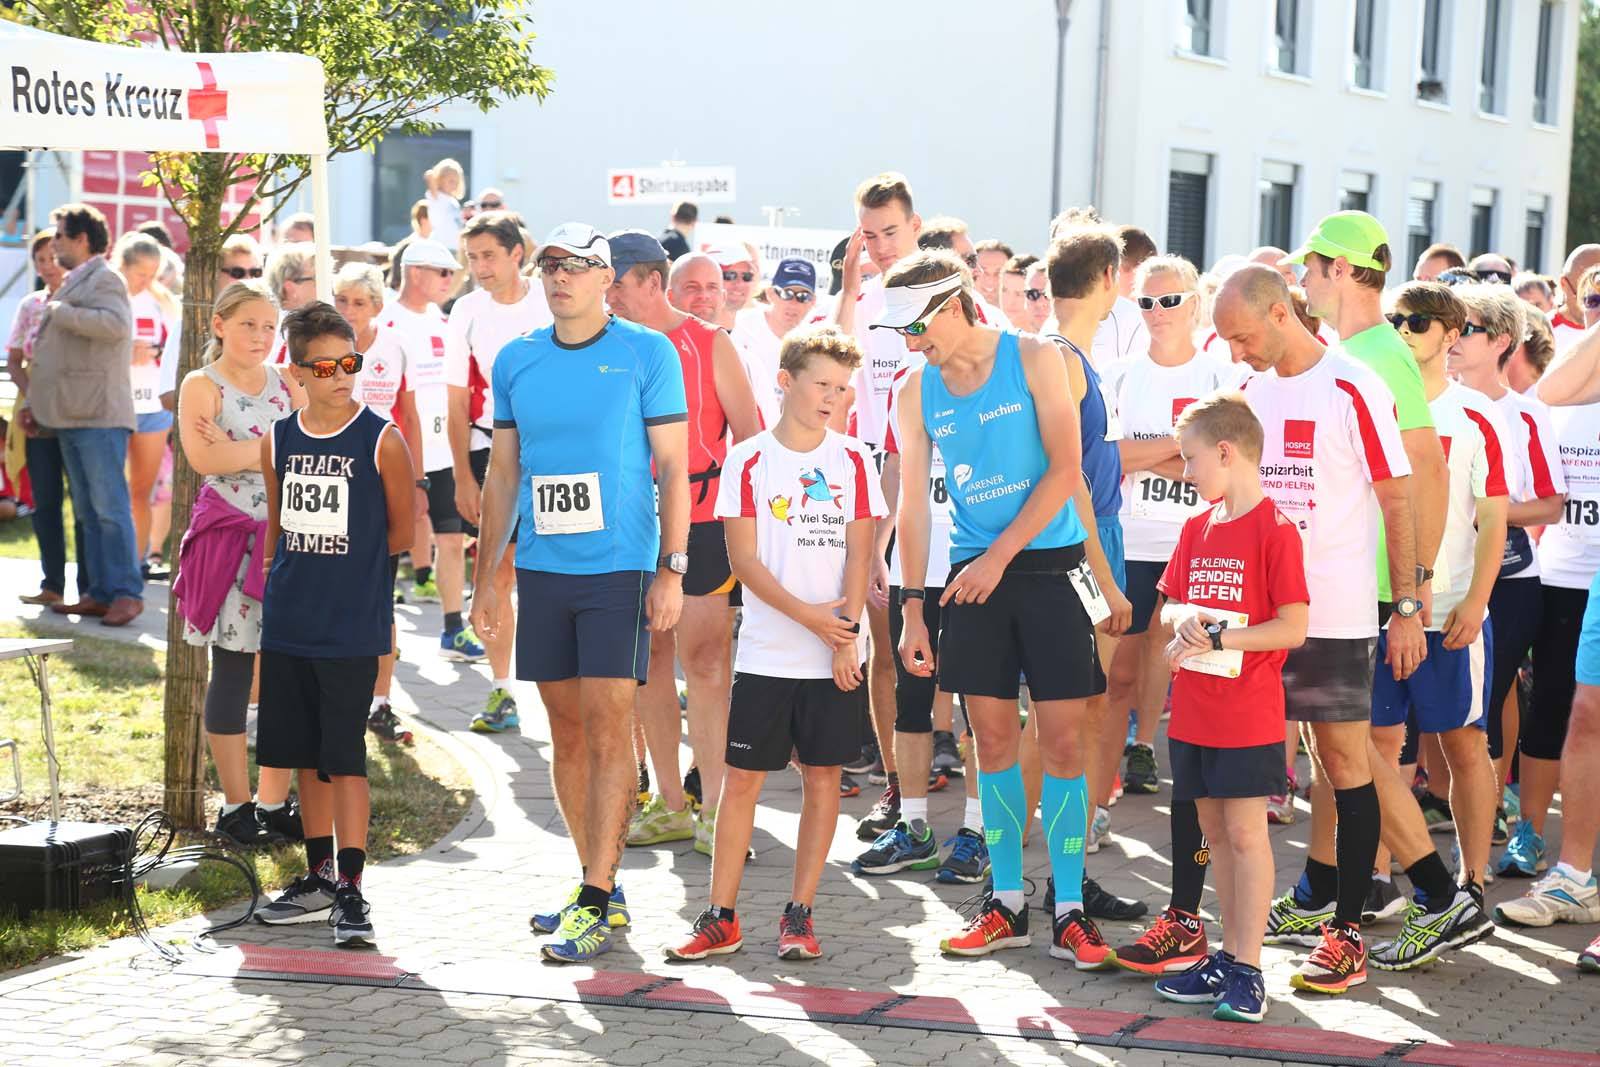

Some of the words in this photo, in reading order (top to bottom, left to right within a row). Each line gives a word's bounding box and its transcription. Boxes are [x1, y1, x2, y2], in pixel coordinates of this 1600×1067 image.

[11, 66, 95, 116] Rotes
[105, 72, 182, 120] Kreuz
[760, 243, 831, 263] tnummer
[979, 401, 1022, 424] Joachim
[933, 422, 957, 439] MSC
[1285, 441, 1312, 450] HOSPIZ
[288, 454, 355, 478] TRACK
[286, 481, 340, 513] 1834
[537, 482, 591, 513] 1738
[966, 478, 1031, 505] PFLEGEDIENST
[1140, 477, 1198, 507] 1945
[800, 514, 819, 523] Viel
[822, 514, 844, 525] Spaß
[797, 537, 816, 547] Max
[818, 537, 826, 547] &
[1201, 557, 1245, 570] KLEINEN
